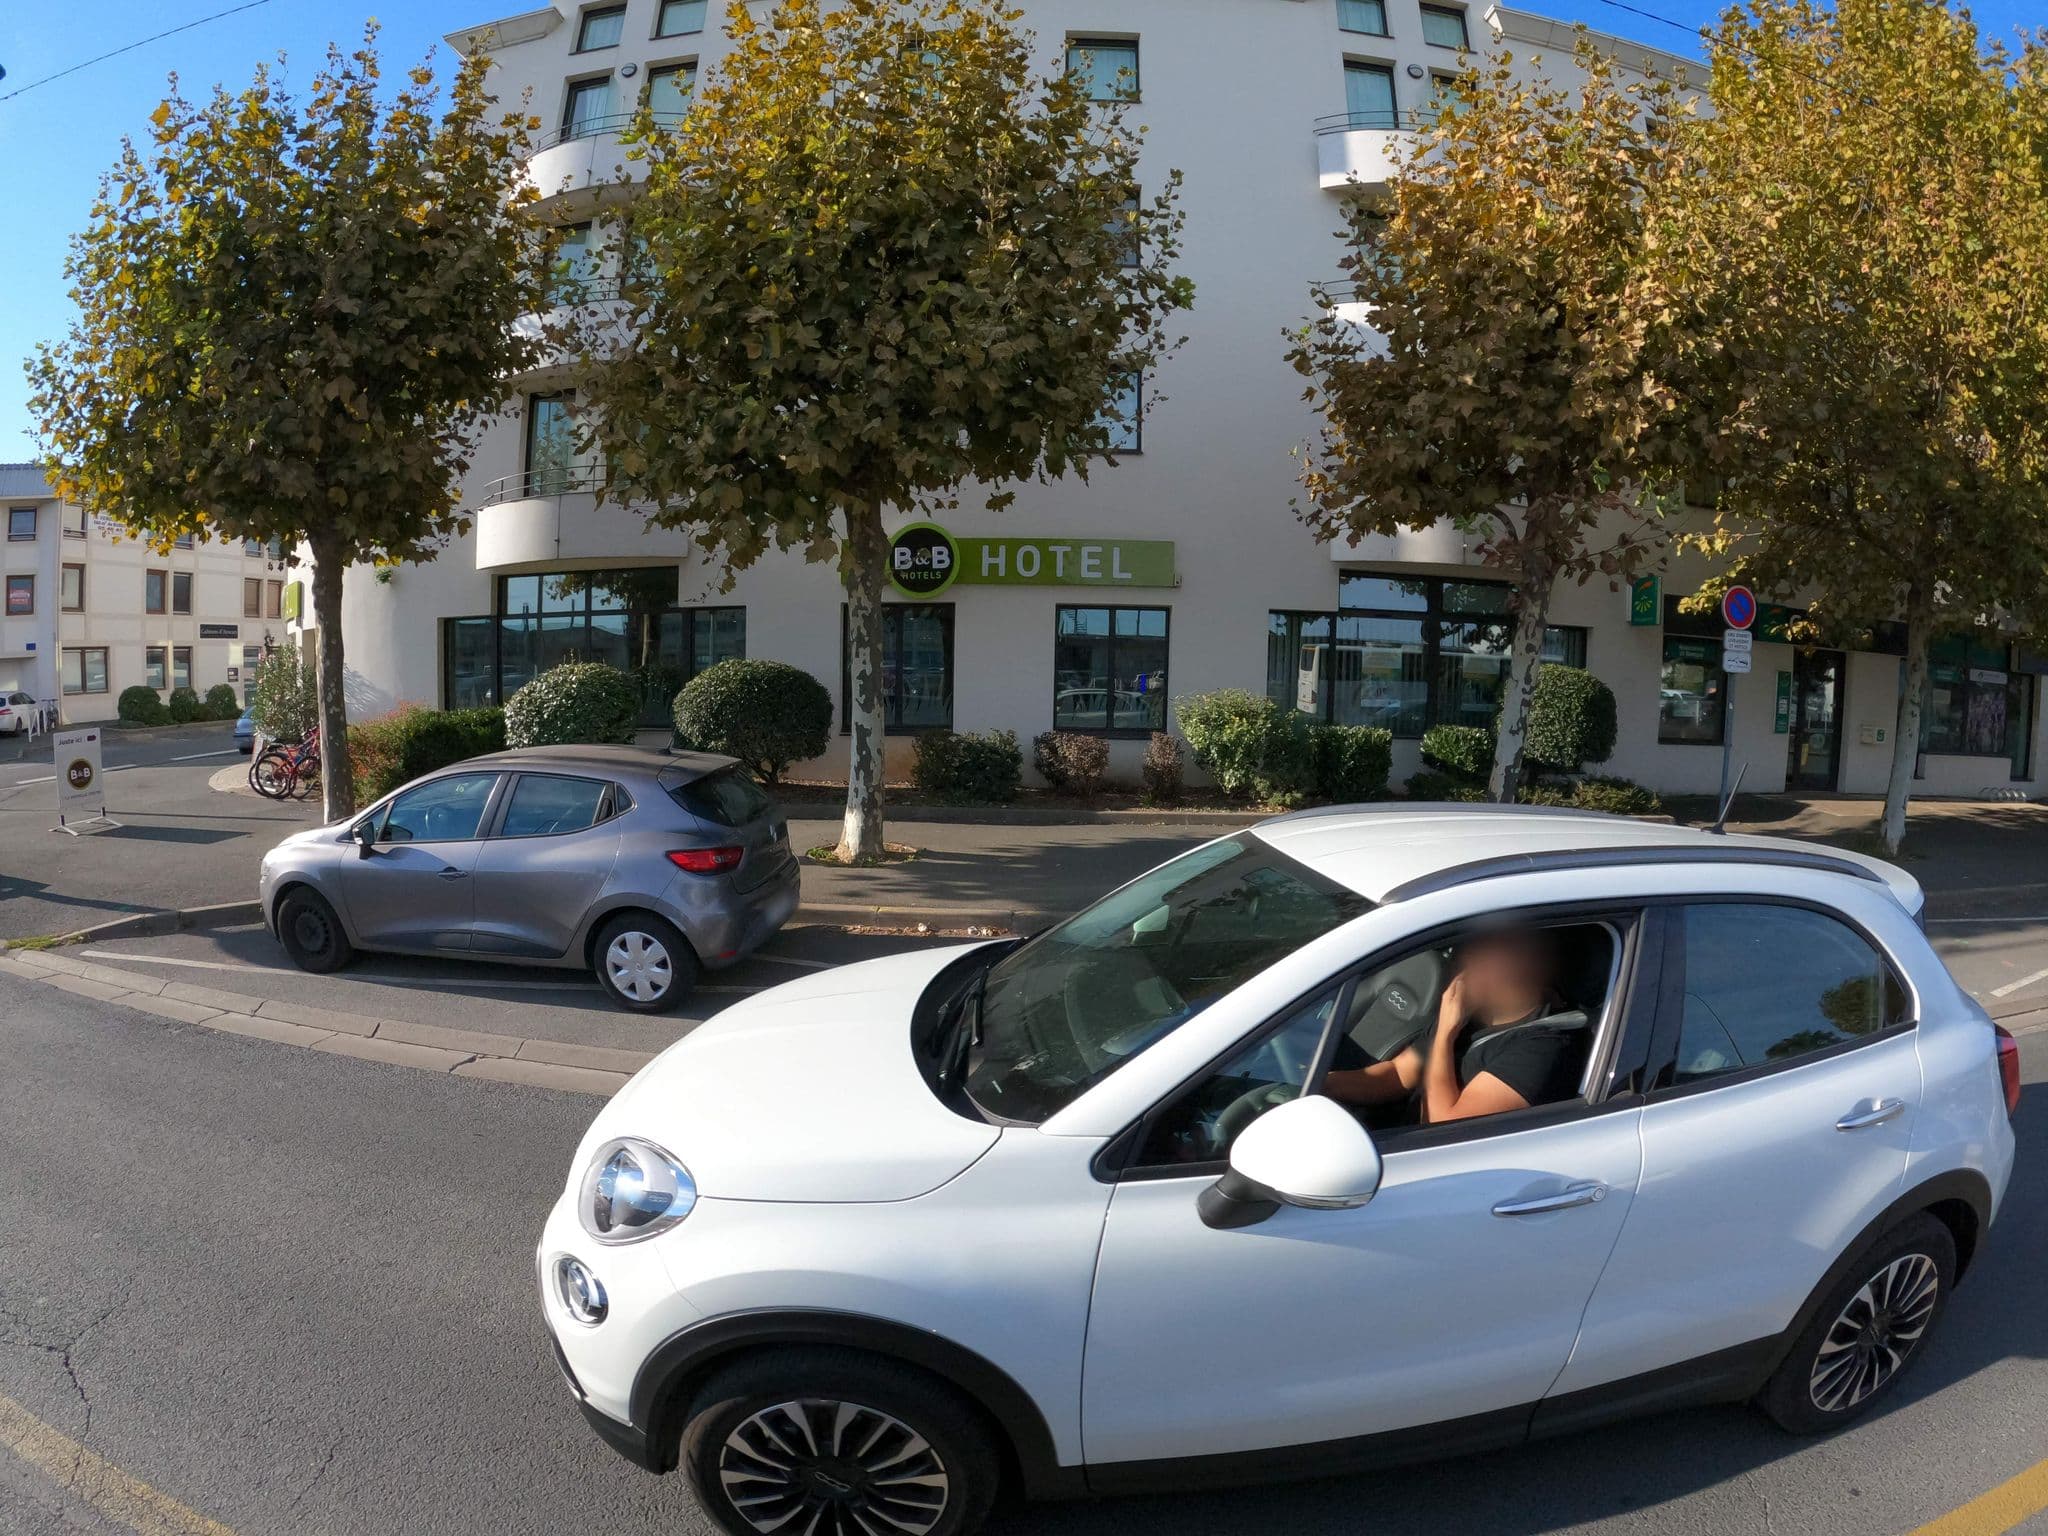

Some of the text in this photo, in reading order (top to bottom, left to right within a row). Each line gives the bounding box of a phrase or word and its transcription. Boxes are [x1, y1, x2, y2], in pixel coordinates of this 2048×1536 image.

[894, 545, 951, 570] B&B
[981, 544, 1133, 580] HOTEL
[900, 571, 943, 581] HOTELS
[70, 767, 91, 780] B&B
